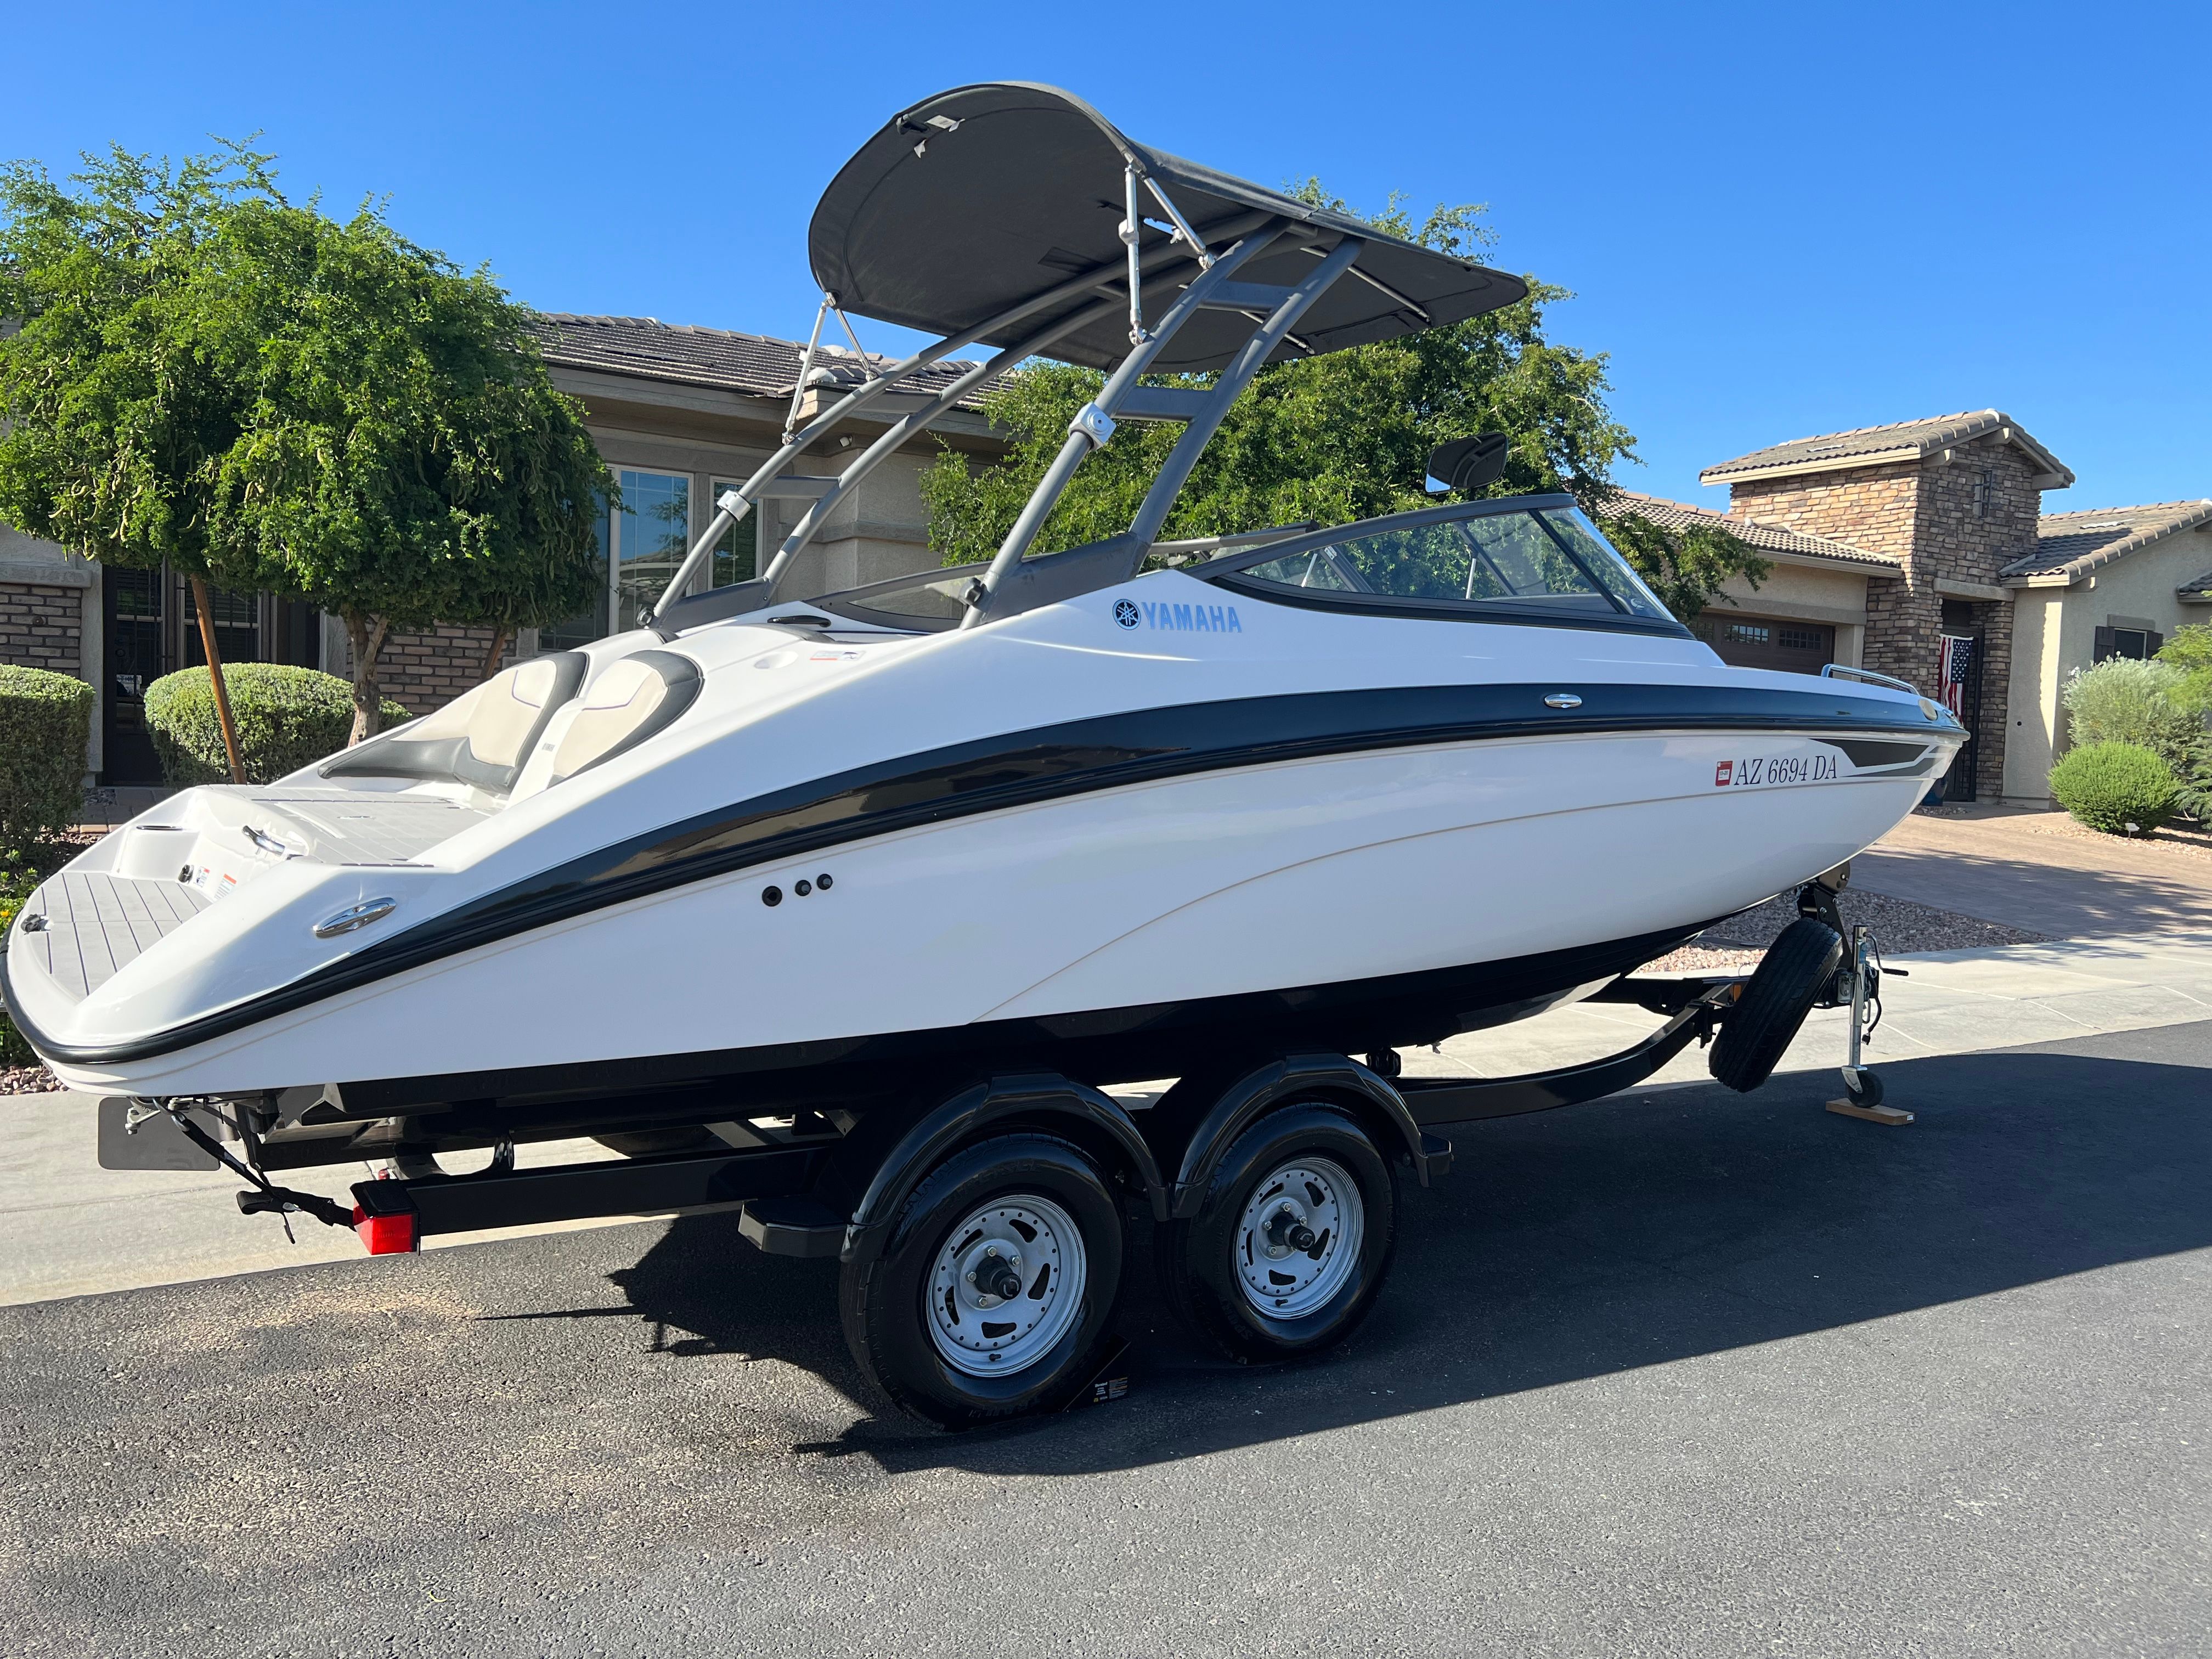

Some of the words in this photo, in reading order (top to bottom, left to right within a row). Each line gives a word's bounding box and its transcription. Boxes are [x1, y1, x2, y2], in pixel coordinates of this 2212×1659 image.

[1141, 602, 1243, 633] YAMAHA
[1734, 758, 1763, 785] AZ
[1768, 758, 1808, 783] 6694
[1812, 754, 1837, 781] DA
